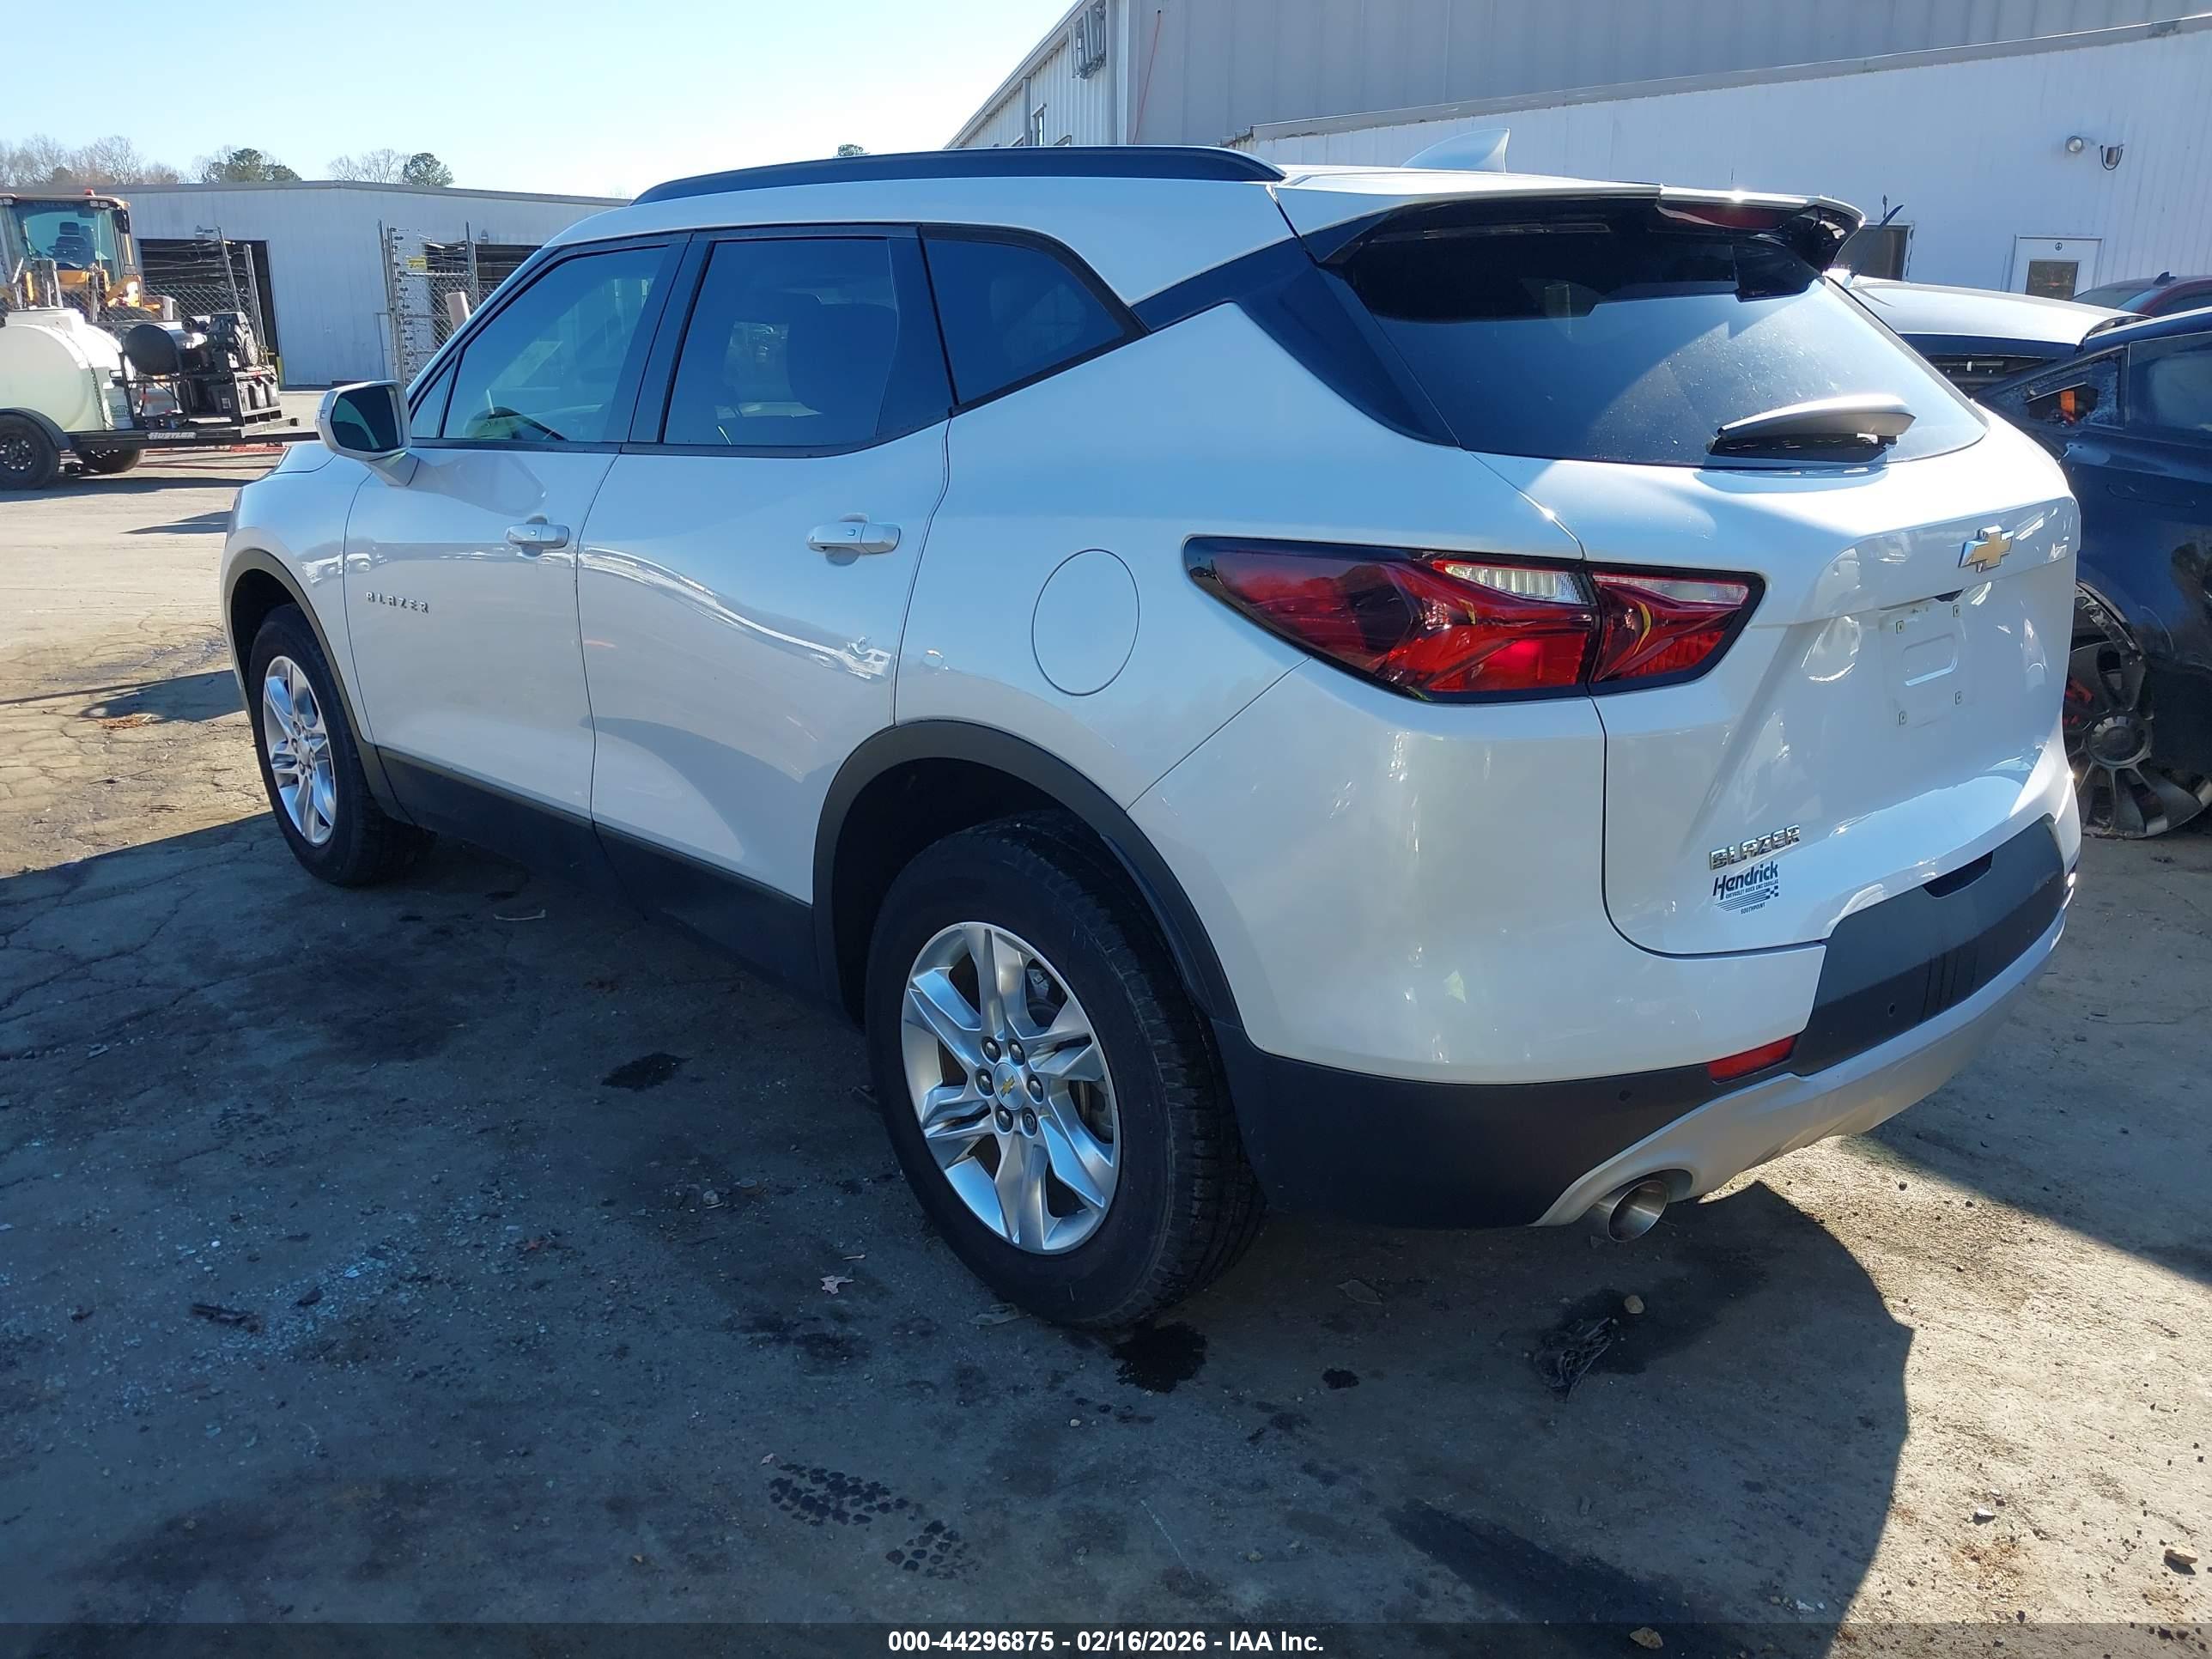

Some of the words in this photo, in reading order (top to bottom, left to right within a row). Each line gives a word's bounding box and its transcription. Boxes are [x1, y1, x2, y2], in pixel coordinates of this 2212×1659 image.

[365, 591, 428, 613] BLAZER
[1710, 824, 1800, 870] BLAZER
[1712, 860, 1778, 900] Hendrick
[1726, 889, 1744, 899] CHEVROLET
[1741, 902, 1765, 915] SOUTHPOINT
